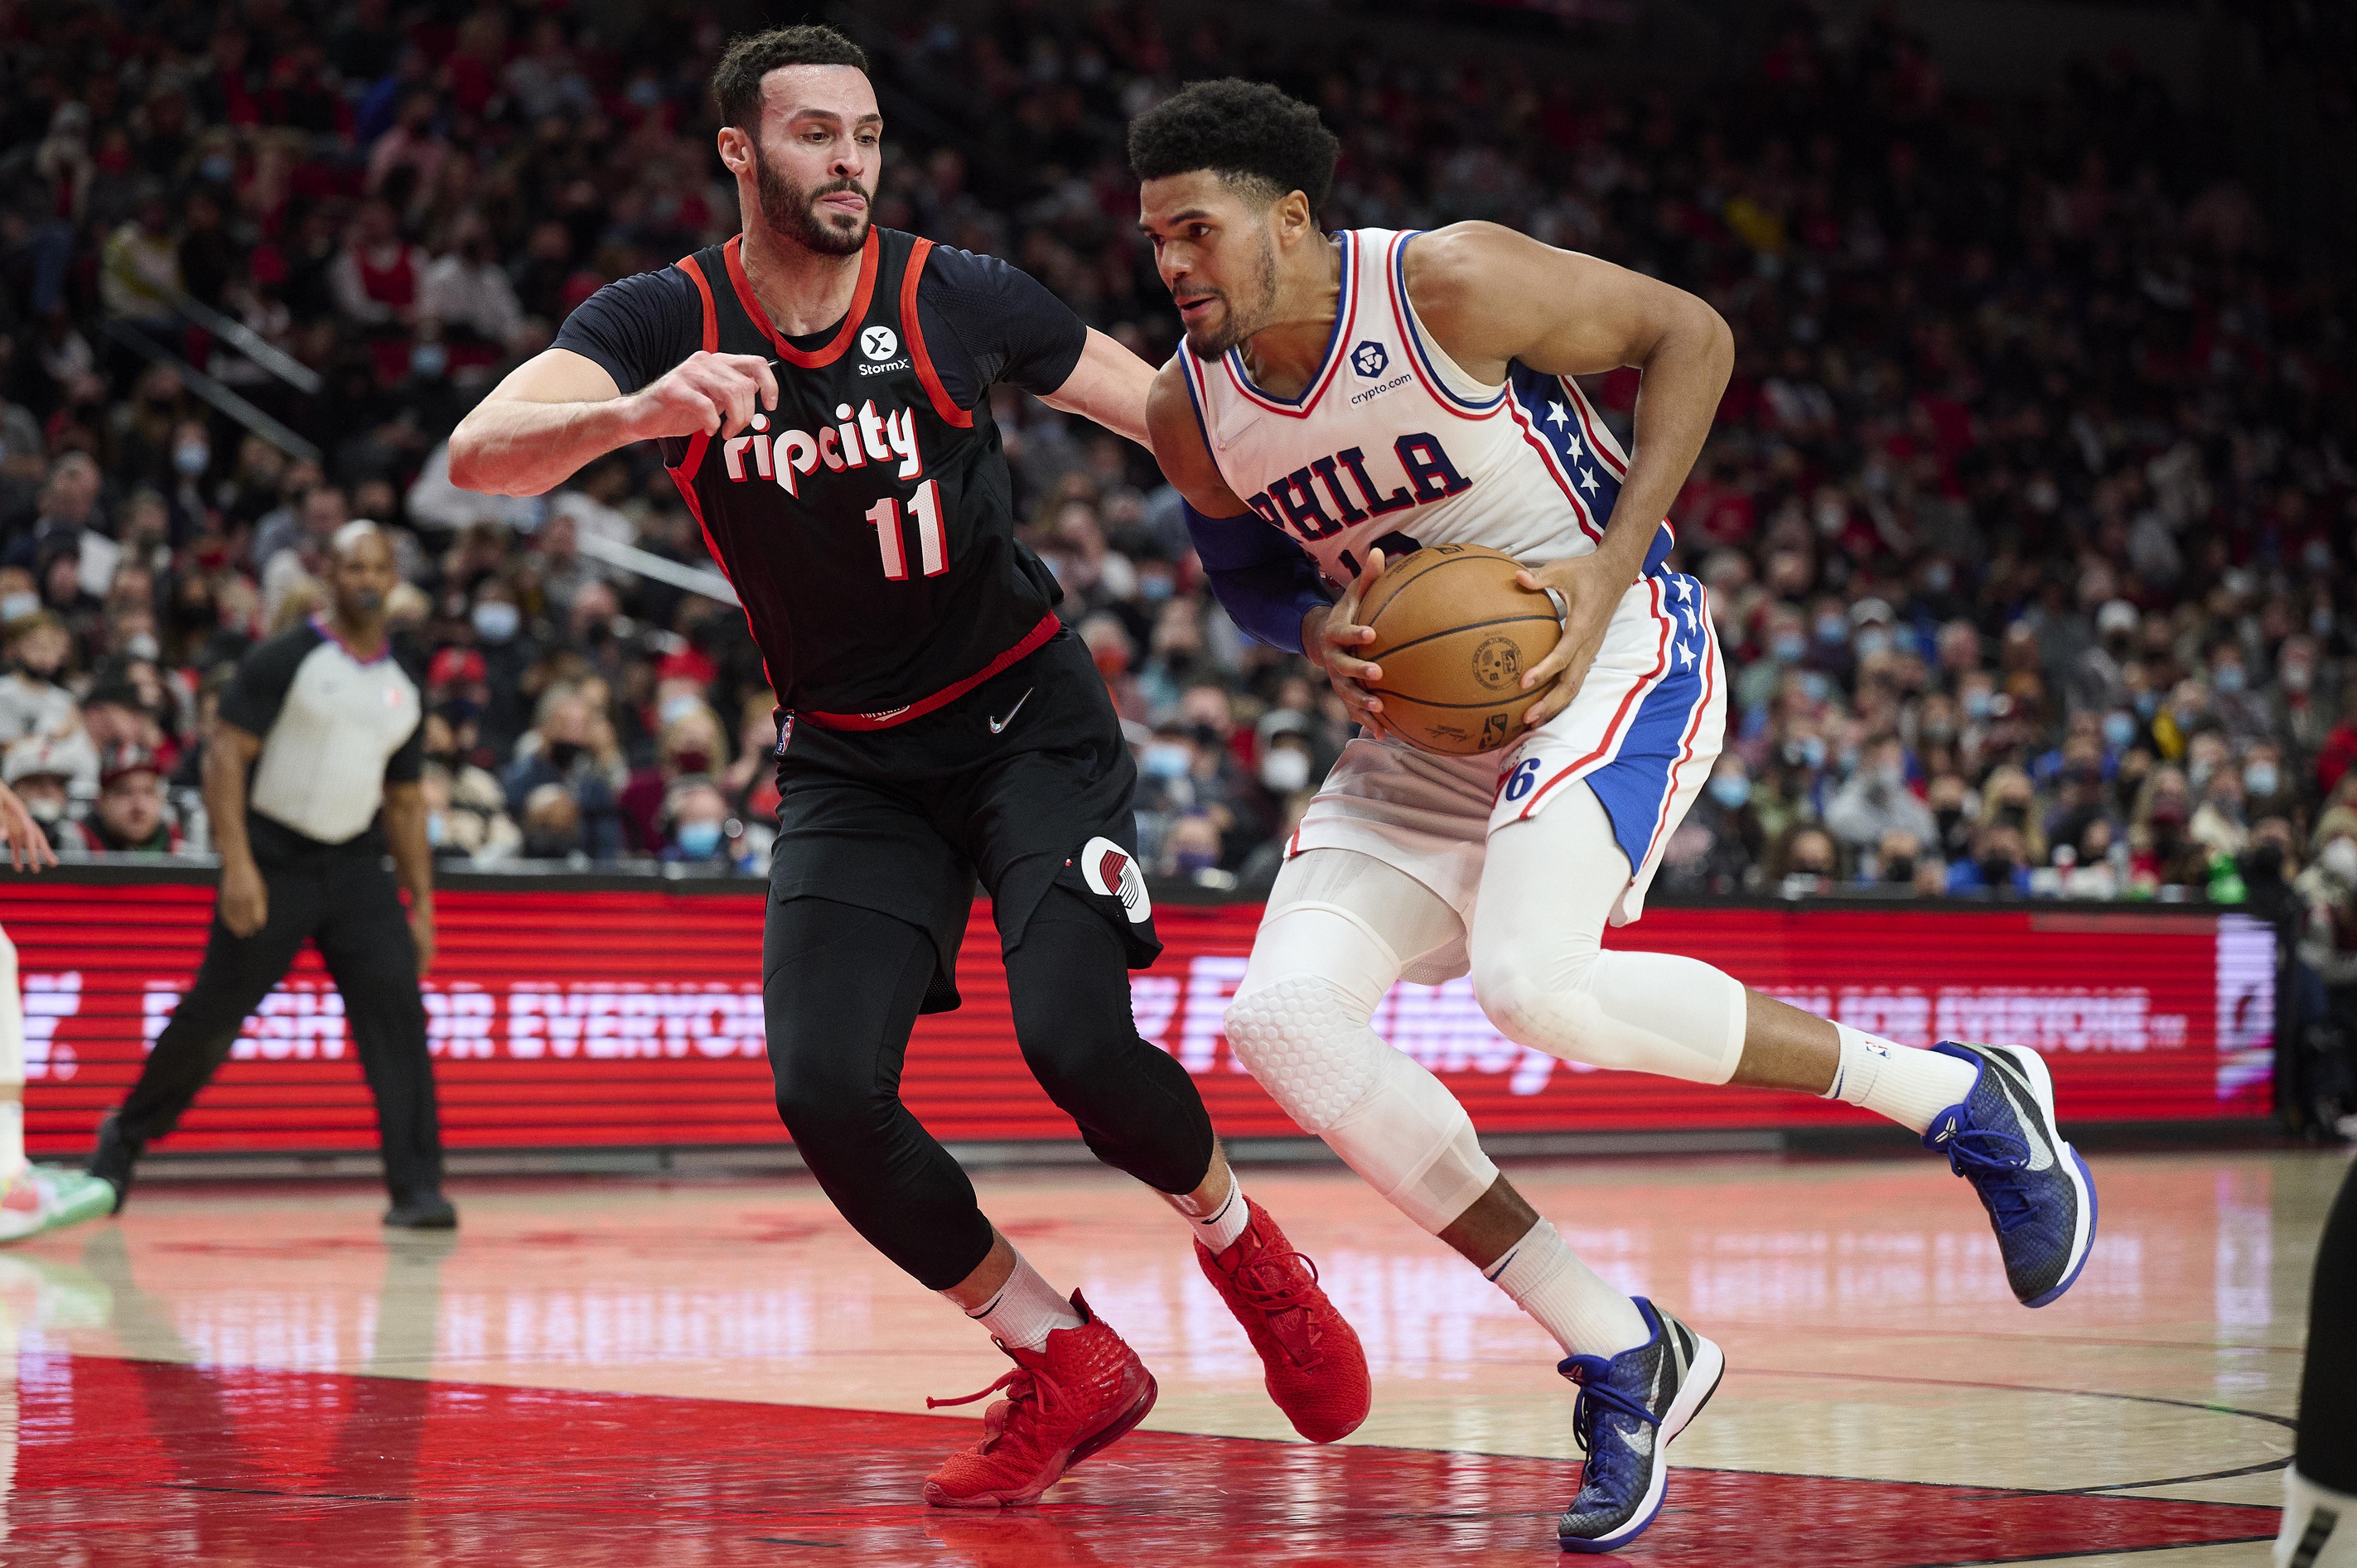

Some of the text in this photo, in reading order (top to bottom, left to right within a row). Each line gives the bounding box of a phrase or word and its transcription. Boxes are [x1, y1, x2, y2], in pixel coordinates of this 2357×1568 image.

[858, 358, 910, 376] StormX
[1351, 374, 1413, 404] crypto.com
[723, 398, 924, 499] ripcity
[1245, 432, 1473, 543] PHILA
[865, 479, 949, 581] 11
[507, 981, 766, 1059] EVERYON
